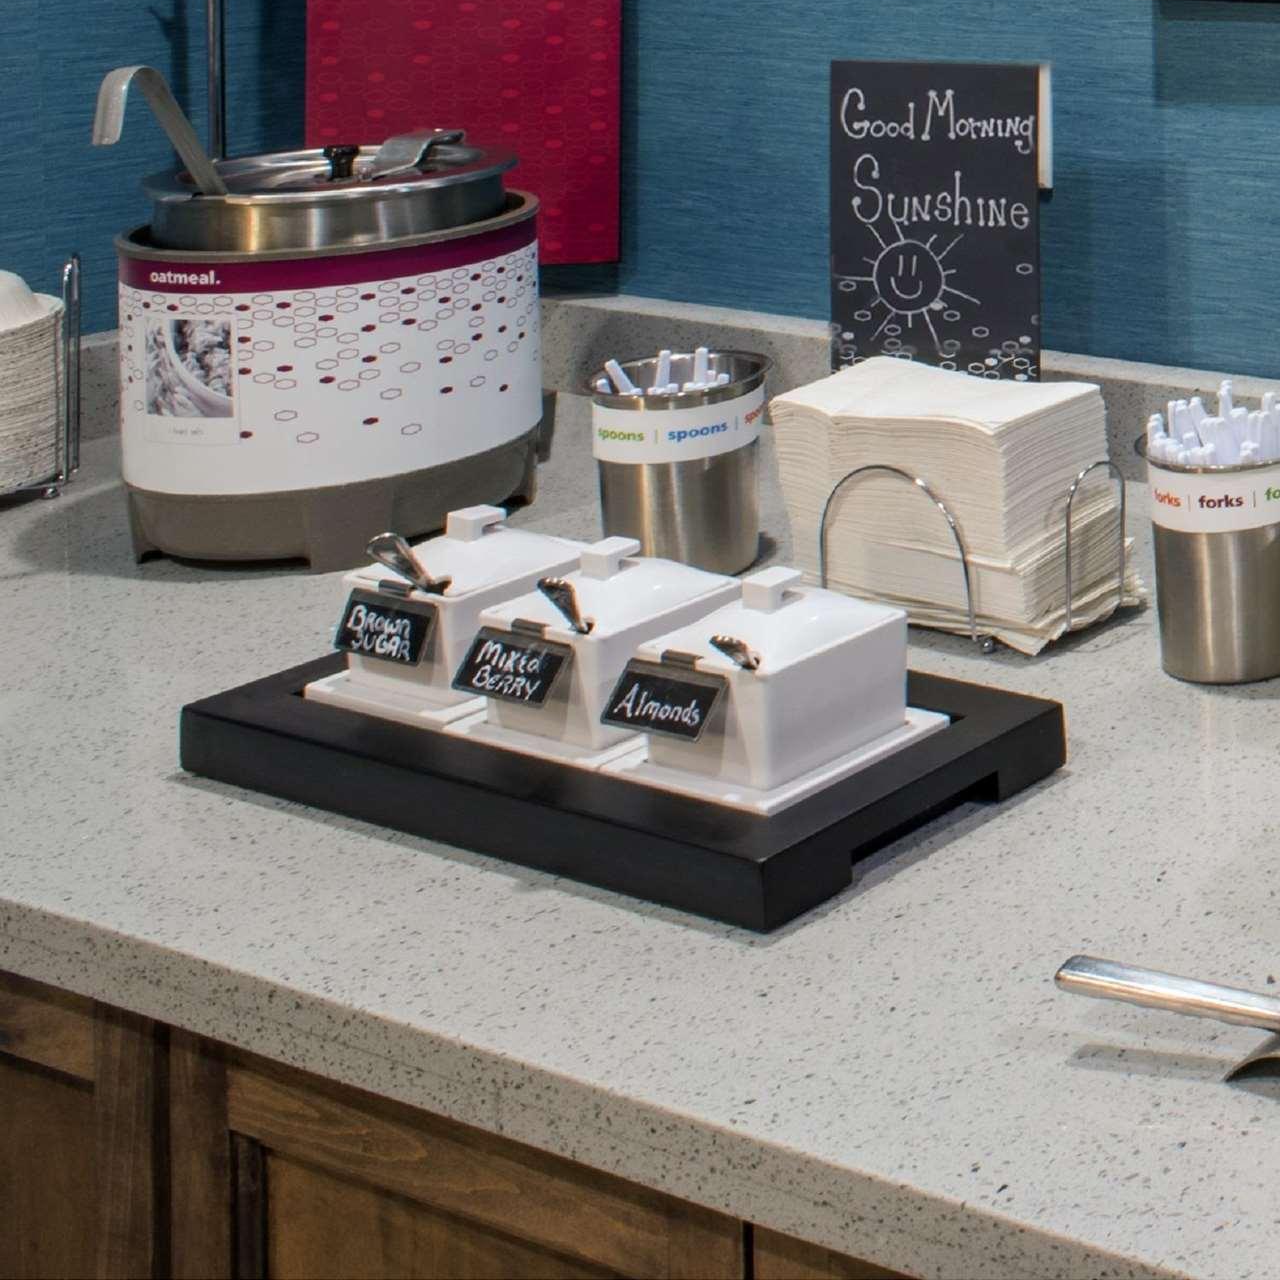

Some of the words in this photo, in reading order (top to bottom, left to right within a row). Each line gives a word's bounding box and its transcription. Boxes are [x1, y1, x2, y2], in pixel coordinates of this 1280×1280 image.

[150, 270, 222, 286] oatmeal.
[668, 421, 728, 443] spoons
[1198, 494, 1245, 509] forks
[613, 682, 700, 727] Almonds
